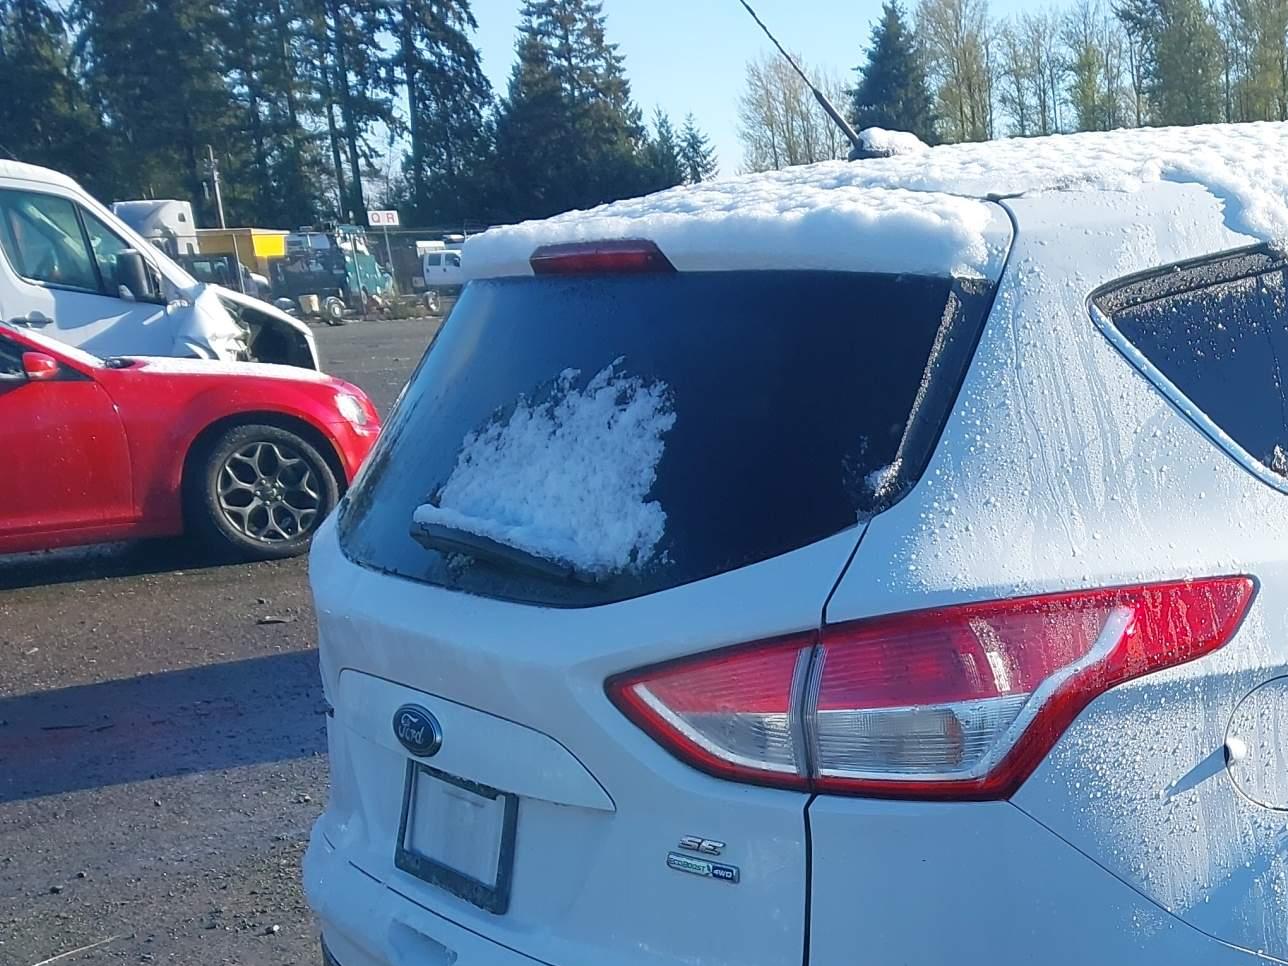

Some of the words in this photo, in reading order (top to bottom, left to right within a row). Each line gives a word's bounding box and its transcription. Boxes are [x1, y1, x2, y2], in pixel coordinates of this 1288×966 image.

[398, 713, 425, 745] Ford
[679, 835, 726, 856] SE
[713, 869, 732, 878] 4WD
